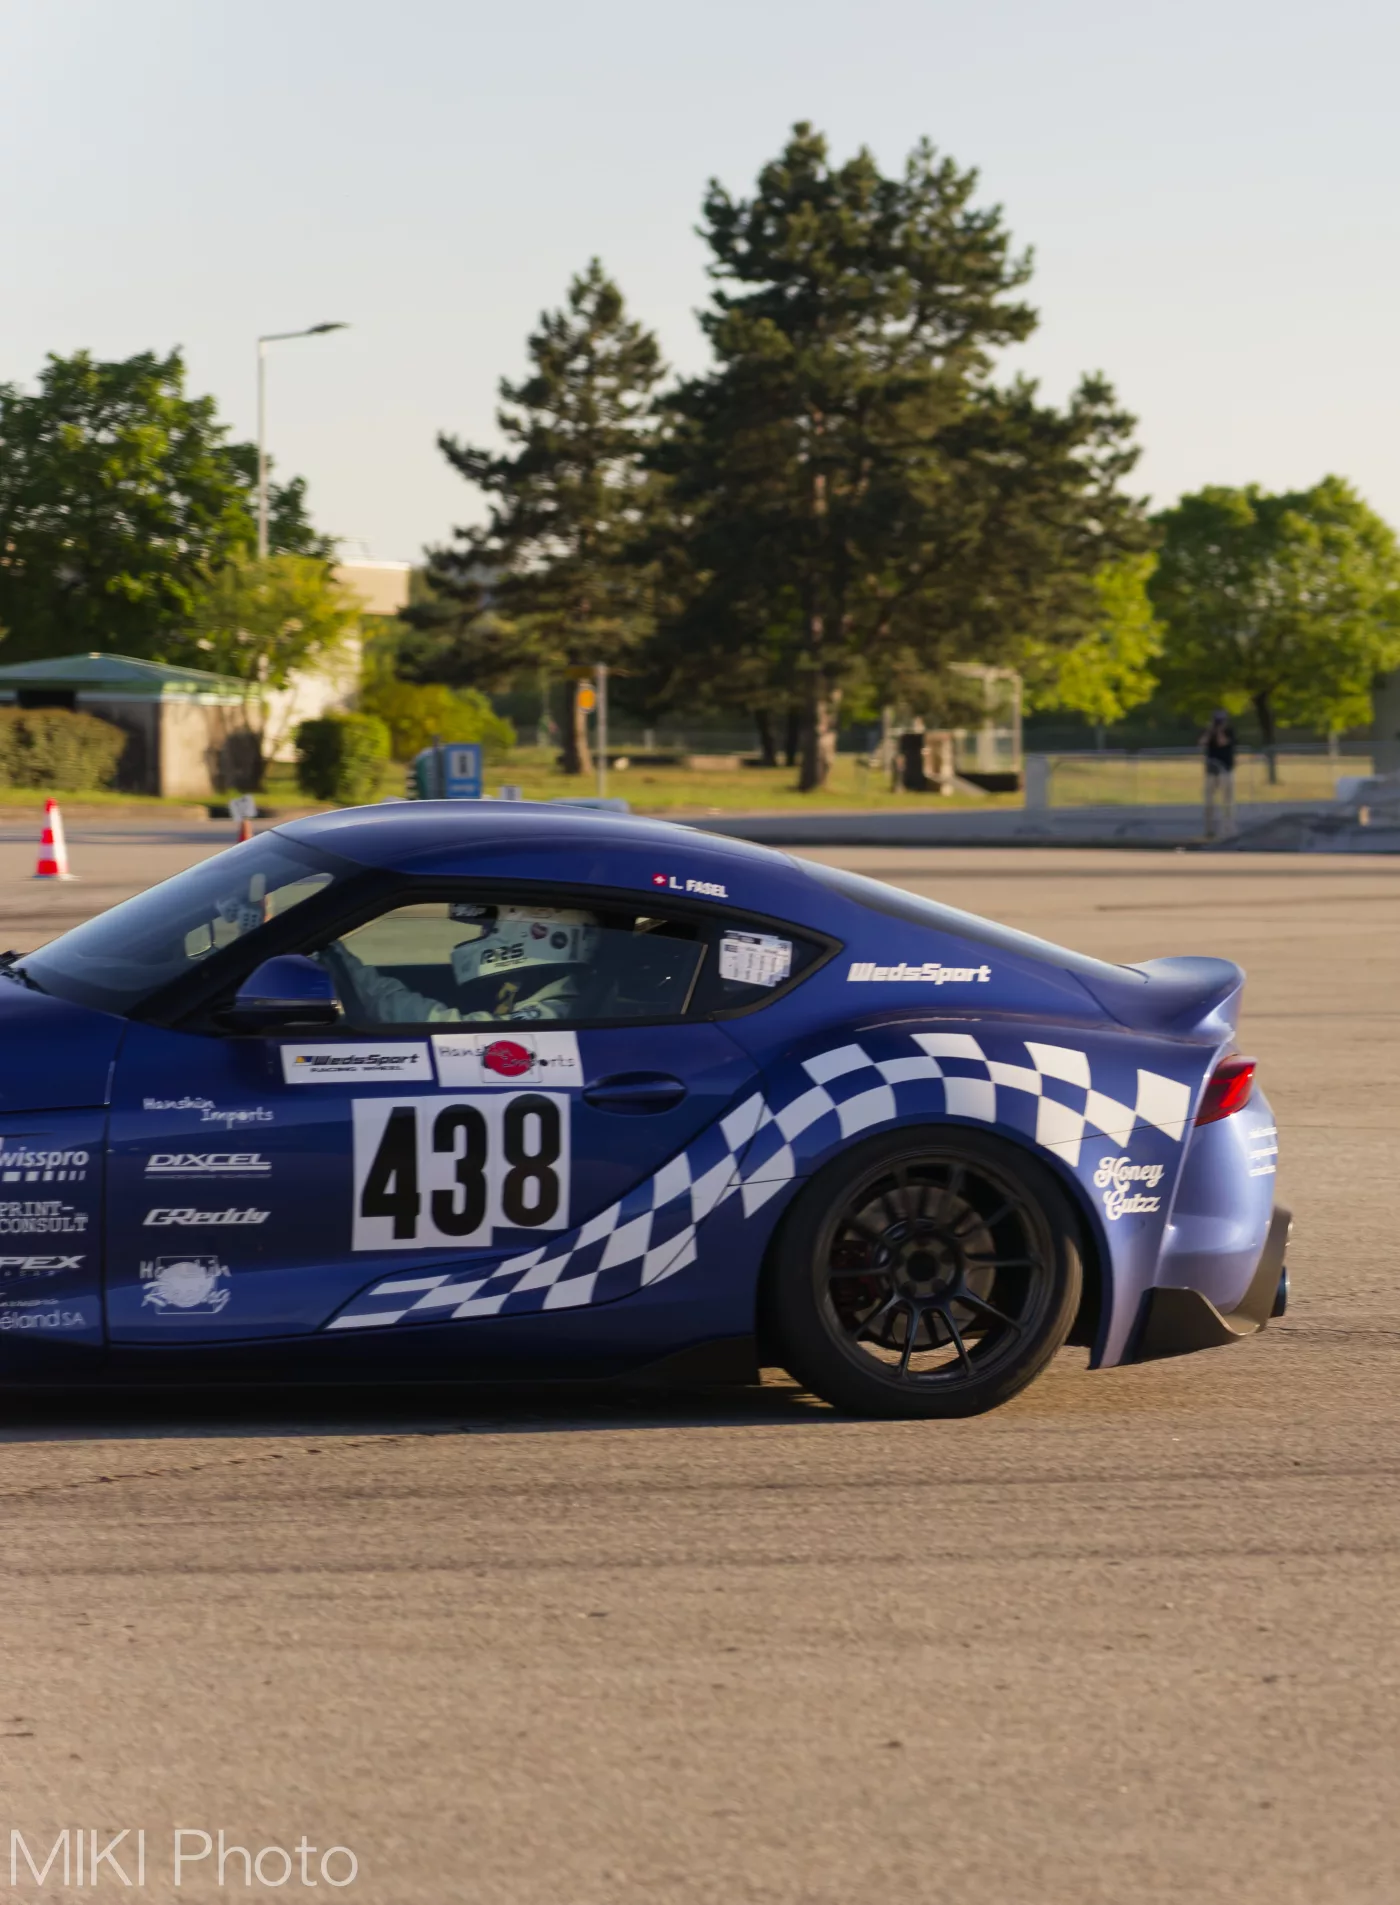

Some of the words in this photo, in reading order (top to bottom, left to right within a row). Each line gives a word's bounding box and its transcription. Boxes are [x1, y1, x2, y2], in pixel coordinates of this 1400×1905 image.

[686, 879, 729, 898] FASEL
[847, 962, 992, 985] WedsSport
[312, 1053, 420, 1066] WedsSport
[146, 1153, 272, 1168] DIXCEL
[360, 1093, 561, 1240] 438
[1093, 1156, 1164, 1192] Honey
[143, 1208, 271, 1226] GReddy
